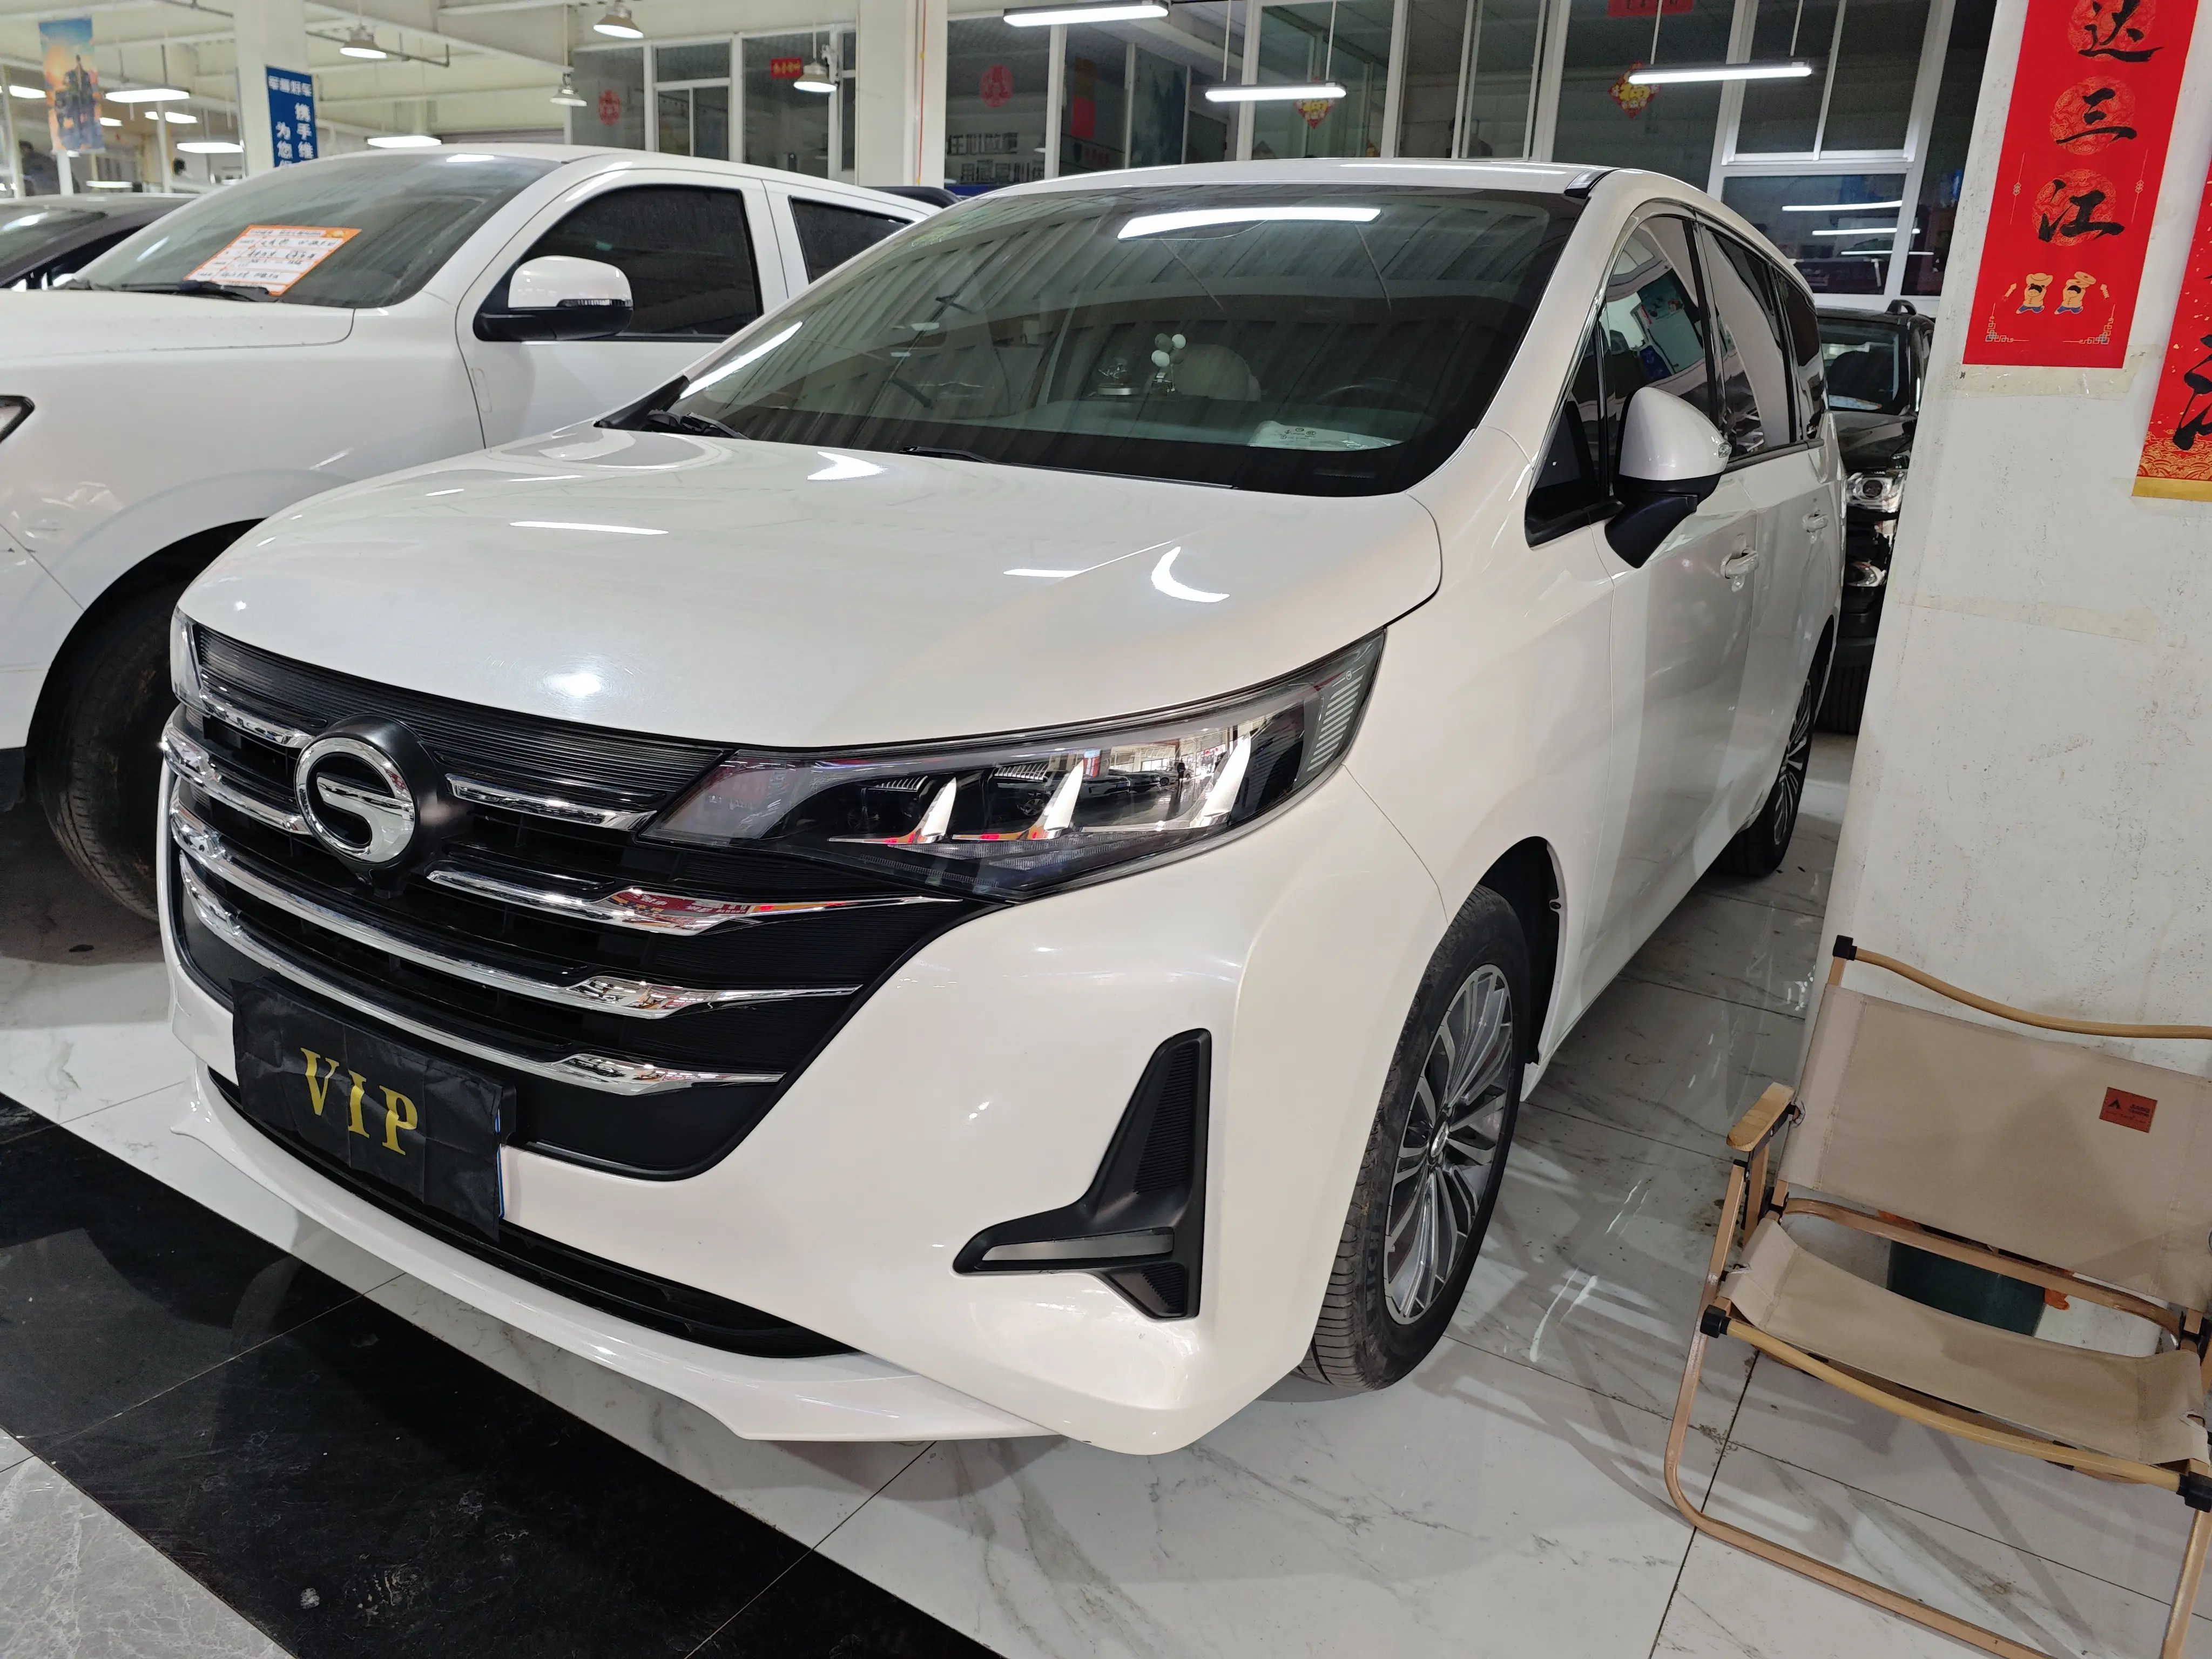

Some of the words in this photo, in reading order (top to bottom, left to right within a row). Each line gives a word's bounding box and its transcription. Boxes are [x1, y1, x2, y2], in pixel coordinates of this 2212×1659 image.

[294, 103, 314, 163] 携手维
[2038, 0, 2164, 242] 达三江
[300, 1047, 418, 1156] VIP
